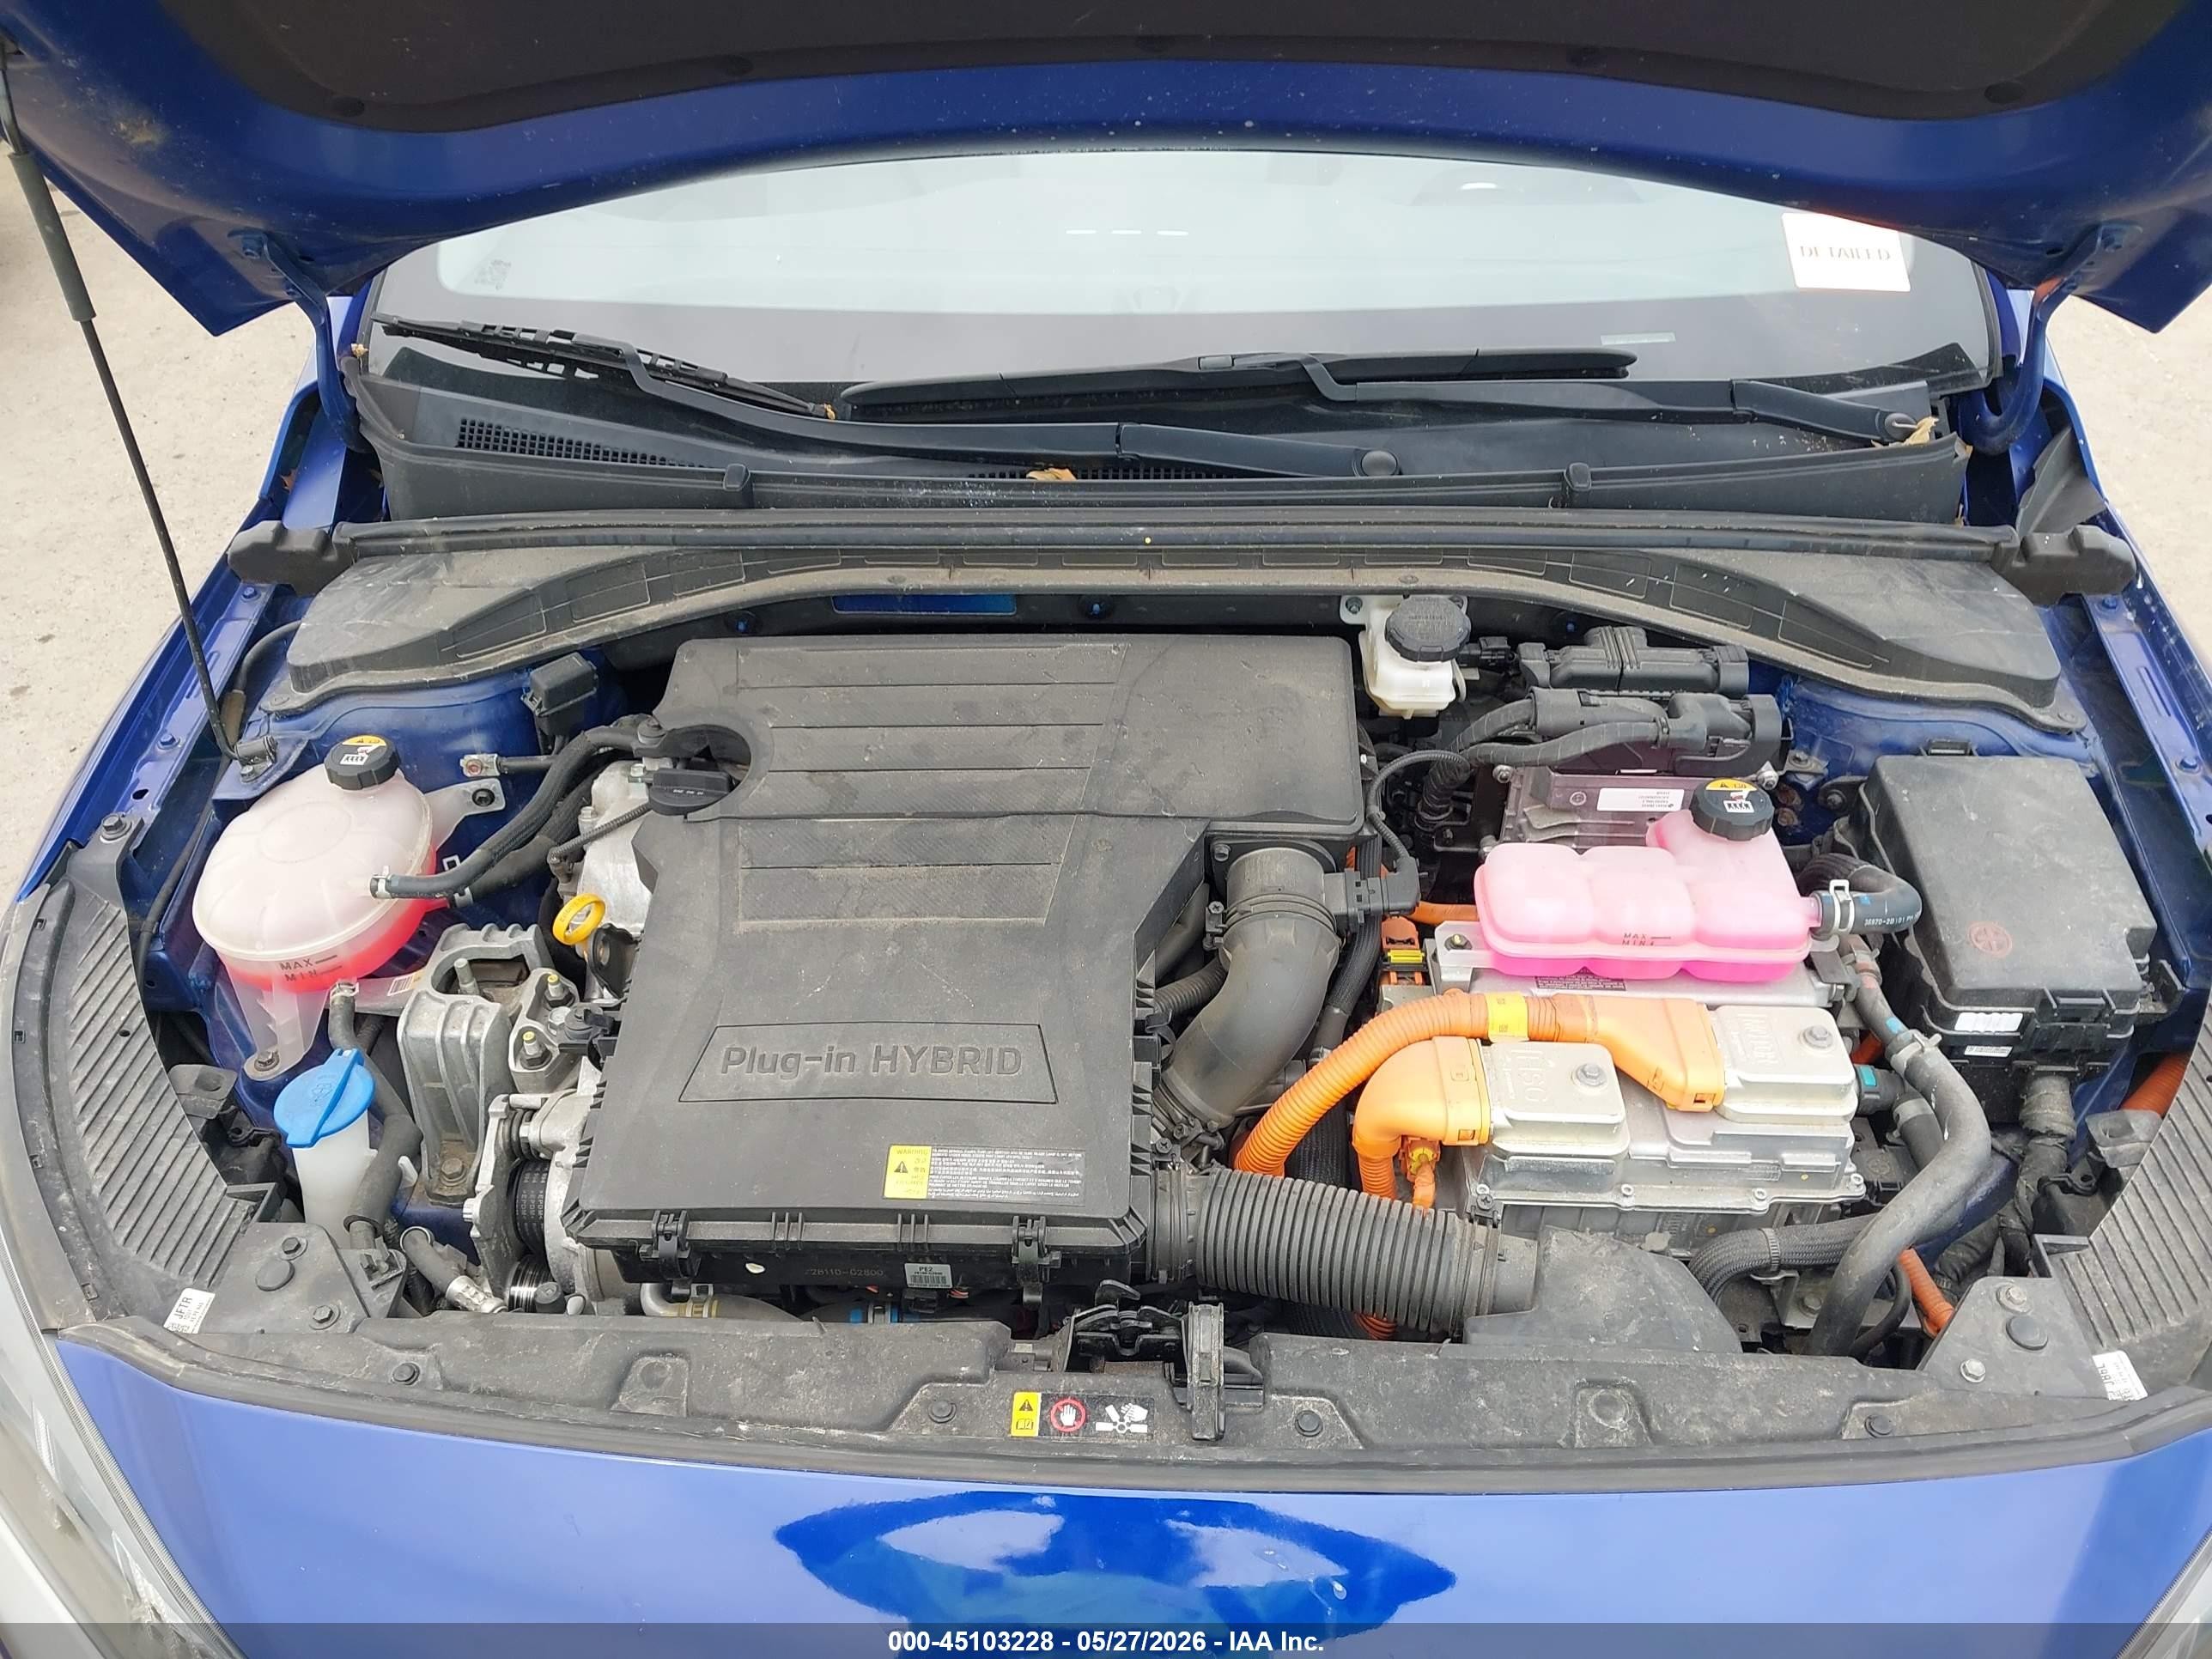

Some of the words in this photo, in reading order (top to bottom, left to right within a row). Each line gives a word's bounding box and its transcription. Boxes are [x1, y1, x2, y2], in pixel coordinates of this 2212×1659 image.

[279, 957, 314, 970] MAX
[283, 969, 318, 982] MIN
[720, 1044, 858, 1080] Plug-in
[871, 1044, 1023, 1077] HYBRID
